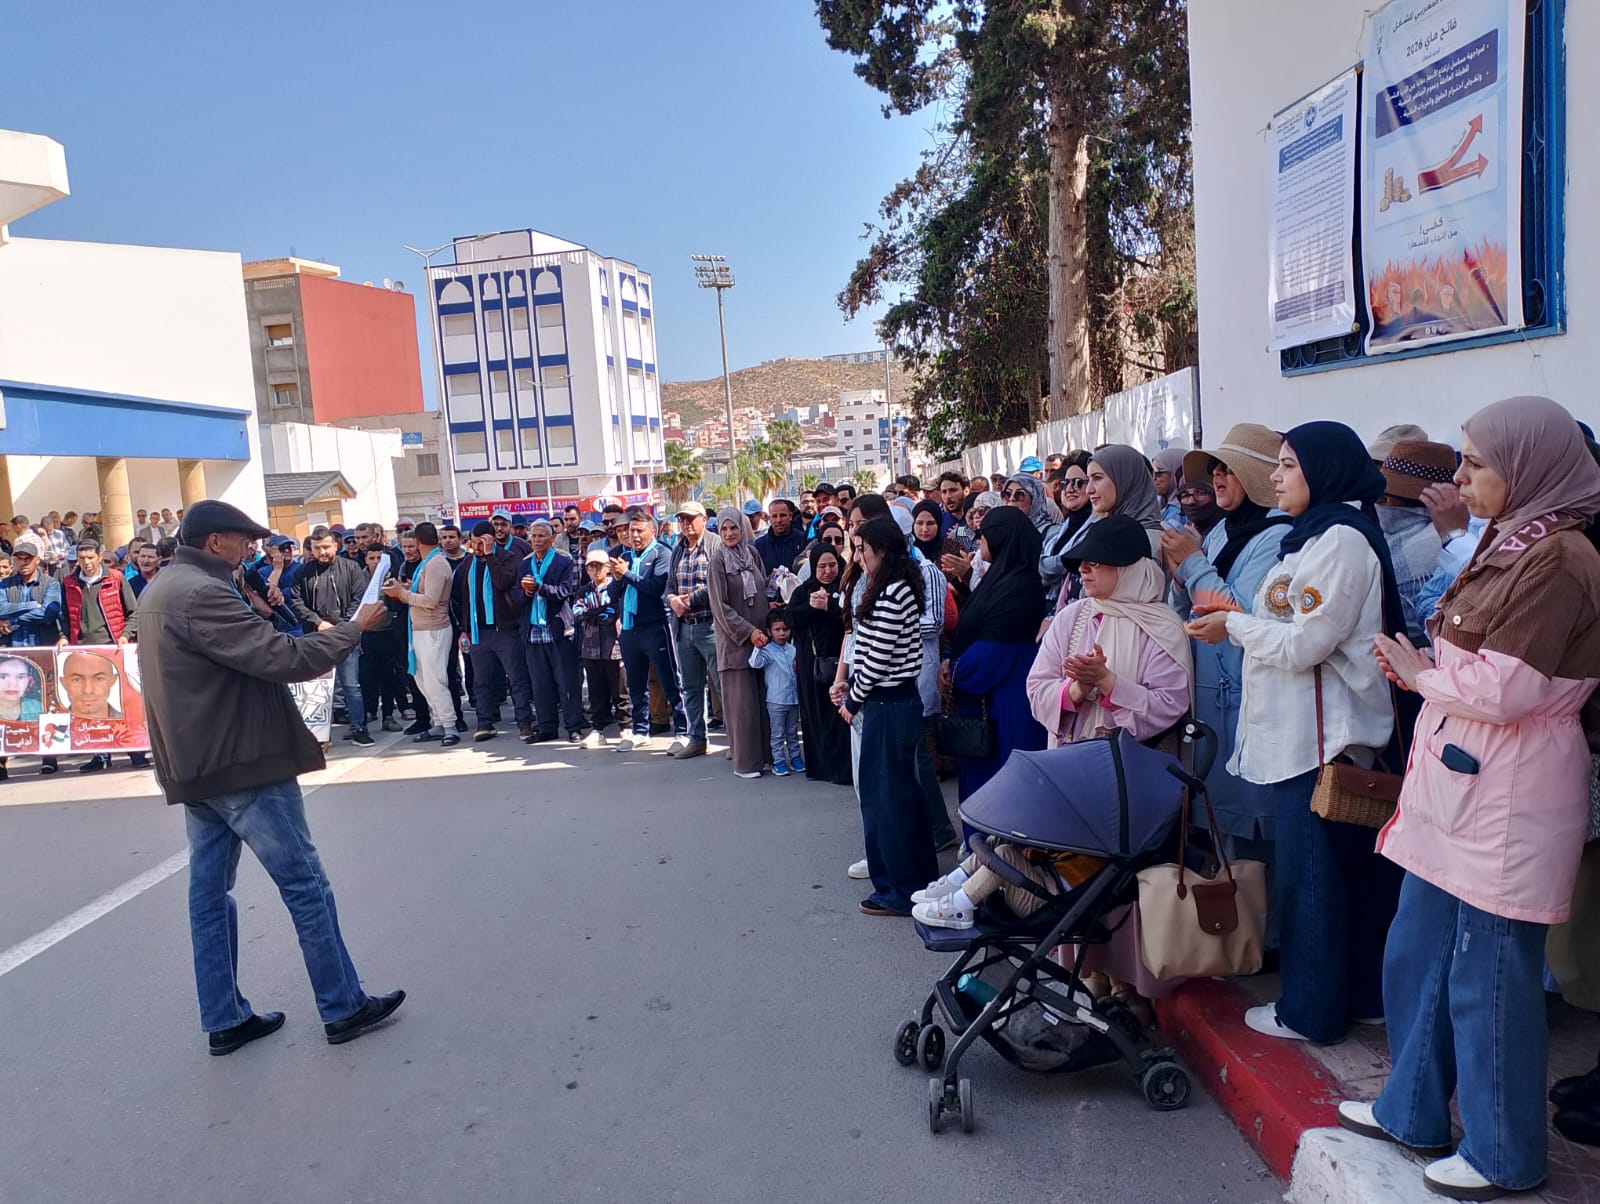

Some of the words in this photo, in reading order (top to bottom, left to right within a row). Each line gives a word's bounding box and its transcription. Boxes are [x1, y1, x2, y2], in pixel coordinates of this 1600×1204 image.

[1440, 17, 1458, 41] فاتح
[1406, 40, 1423, 57] 2026
[1424, 31, 1439, 51] ماي
[77, 721, 112, 732] كمال
